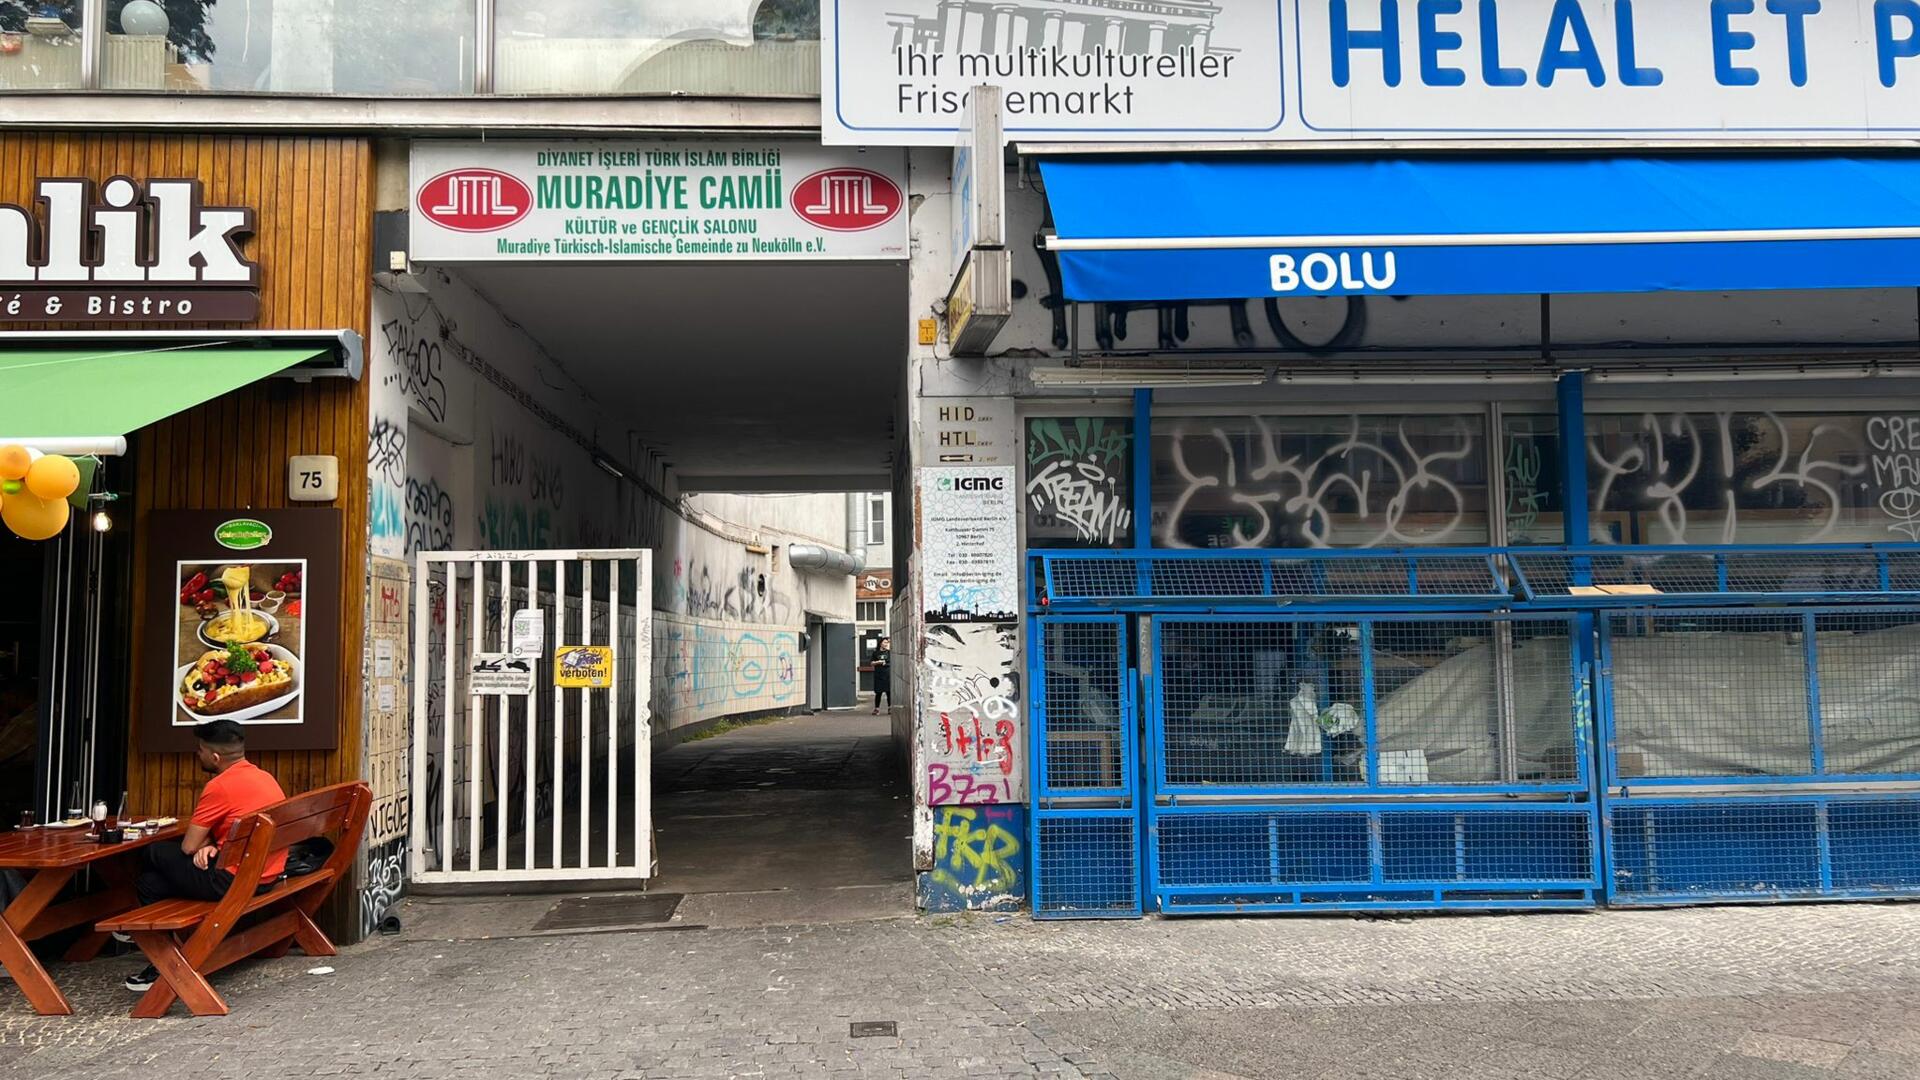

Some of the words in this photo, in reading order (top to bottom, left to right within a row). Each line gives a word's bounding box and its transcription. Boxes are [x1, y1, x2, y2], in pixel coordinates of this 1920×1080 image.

[1329, 0, 1664, 88] HELAL
[1710, 0, 1822, 88] ET
[898, 46, 943, 78] Ihr
[960, 46, 1234, 79] multikultureller
[898, 82, 1134, 115] Frisemarkt
[537, 148, 594, 167] DİYANET
[598, 148, 641, 170] İŞLERİ
[645, 148, 681, 167] TÜRK
[732, 147, 781, 167] BİRLİĞİ
[537, 169, 688, 210] MURADİYE
[699, 168, 783, 210] CAMİİ
[565, 217, 617, 235] KÜLTÜR
[621, 222, 638, 235] ve
[642, 216, 699, 240] GENÇLİK
[703, 218, 757, 234] SALONU
[497, 238, 551, 257] Muradiye
[554, 238, 672, 255] Türkisch-Islamische
[676, 238, 733, 254] Gemeinde
[736, 241, 749, 254] zu
[752, 238, 802, 253] Neukölln
[805, 237, 827, 253] e.V.
[1268, 250, 1397, 292] BOLU
[0, 293, 21, 316] é
[45, 295, 63, 316] &
[87, 294, 193, 315] Bistro
[939, 406, 975, 422] HID
[940, 431, 975, 446] HTL
[300, 471, 323, 489] 75
